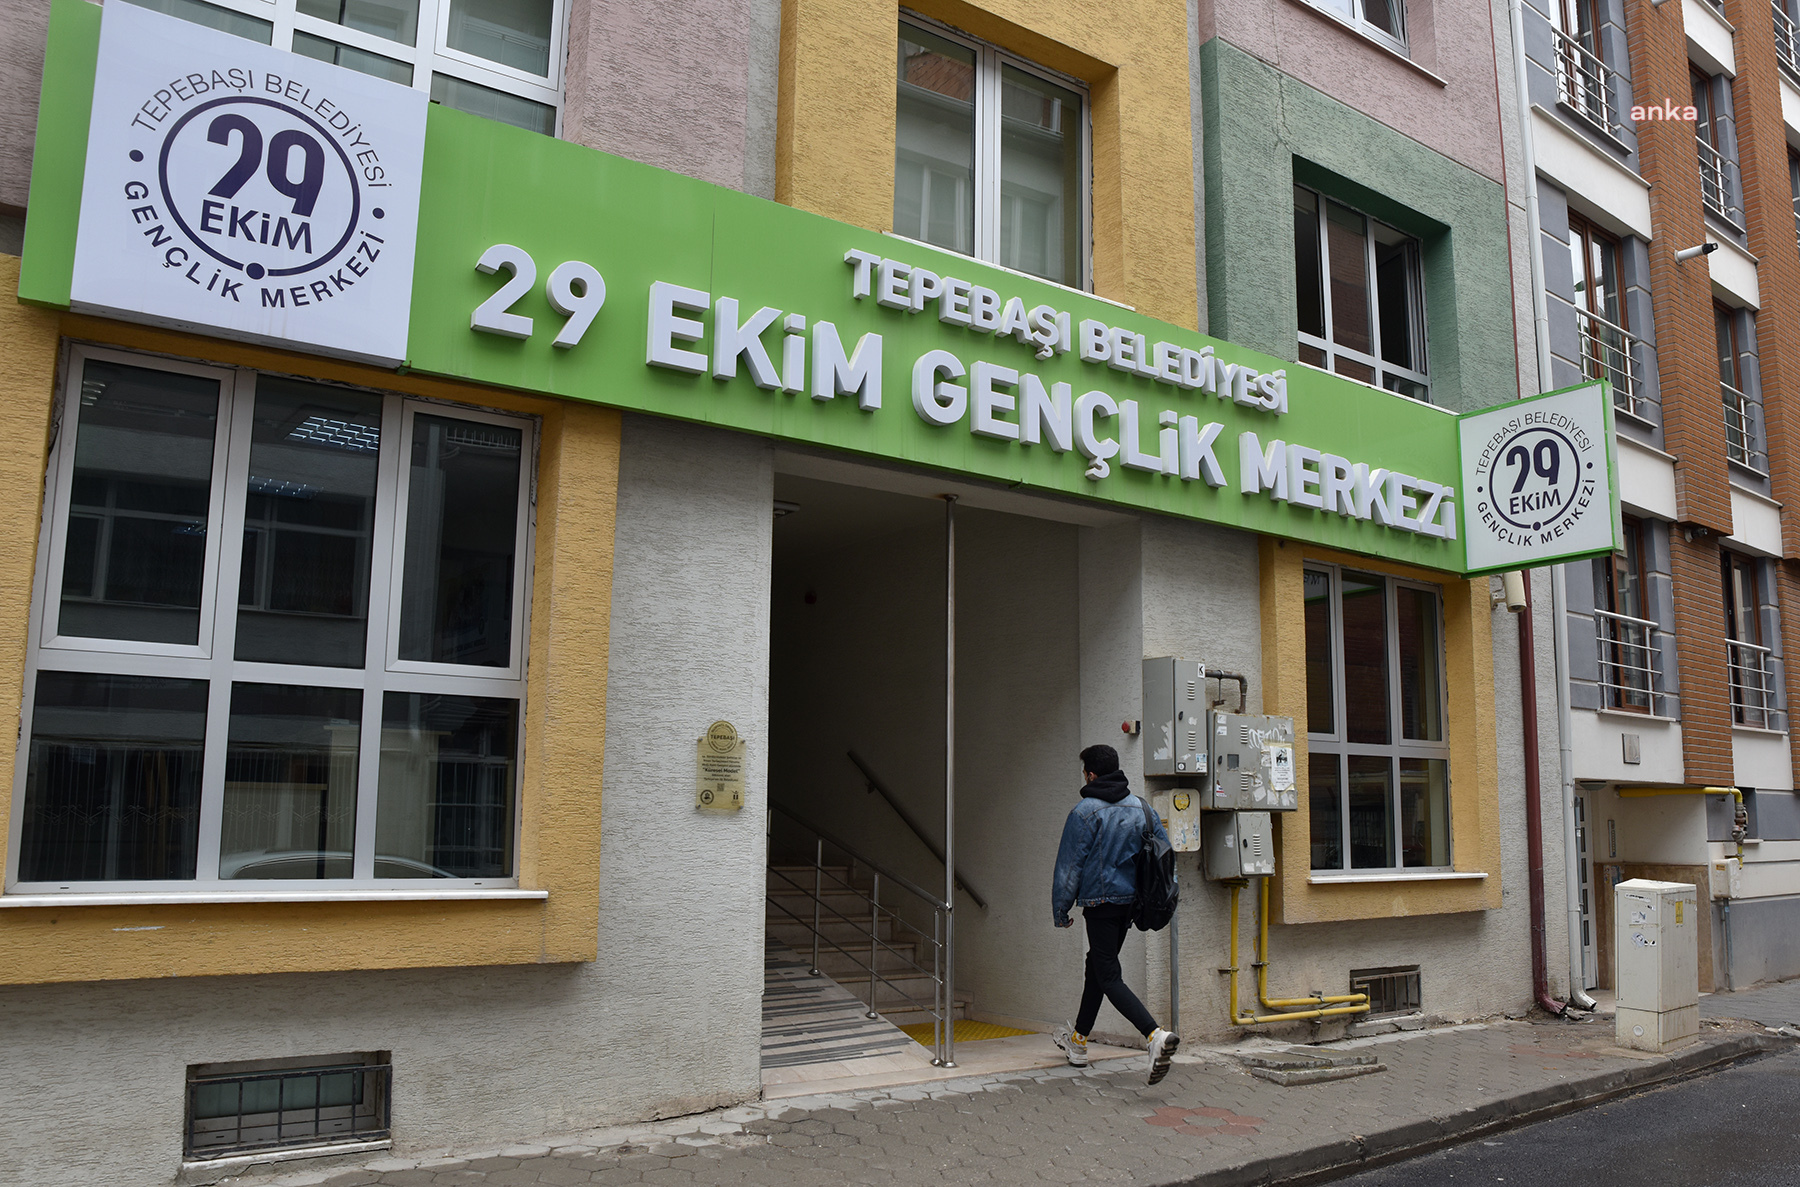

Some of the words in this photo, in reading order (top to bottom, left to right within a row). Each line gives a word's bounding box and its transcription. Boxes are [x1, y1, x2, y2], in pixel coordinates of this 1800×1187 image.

[131, 68, 254, 132] TEPEBAŞI
[265, 73, 392, 188] BELEDİYESİ
[206, 113, 325, 217] 29
[124, 181, 244, 302] GENÇLİK
[261, 231, 385, 308] MERKEZİ
[470, 243, 606, 349] 29
[844, 248, 1071, 361] TEPEBAŞI
[1079, 318, 1288, 416] BELEDİYESİ
[1475, 417, 1522, 476] TEPEBAŞI
[1524, 412, 1594, 453] BELEDİYESİ
[1506, 438, 1560, 494] 29
[1540, 479, 1595, 545] MERKEZİ
